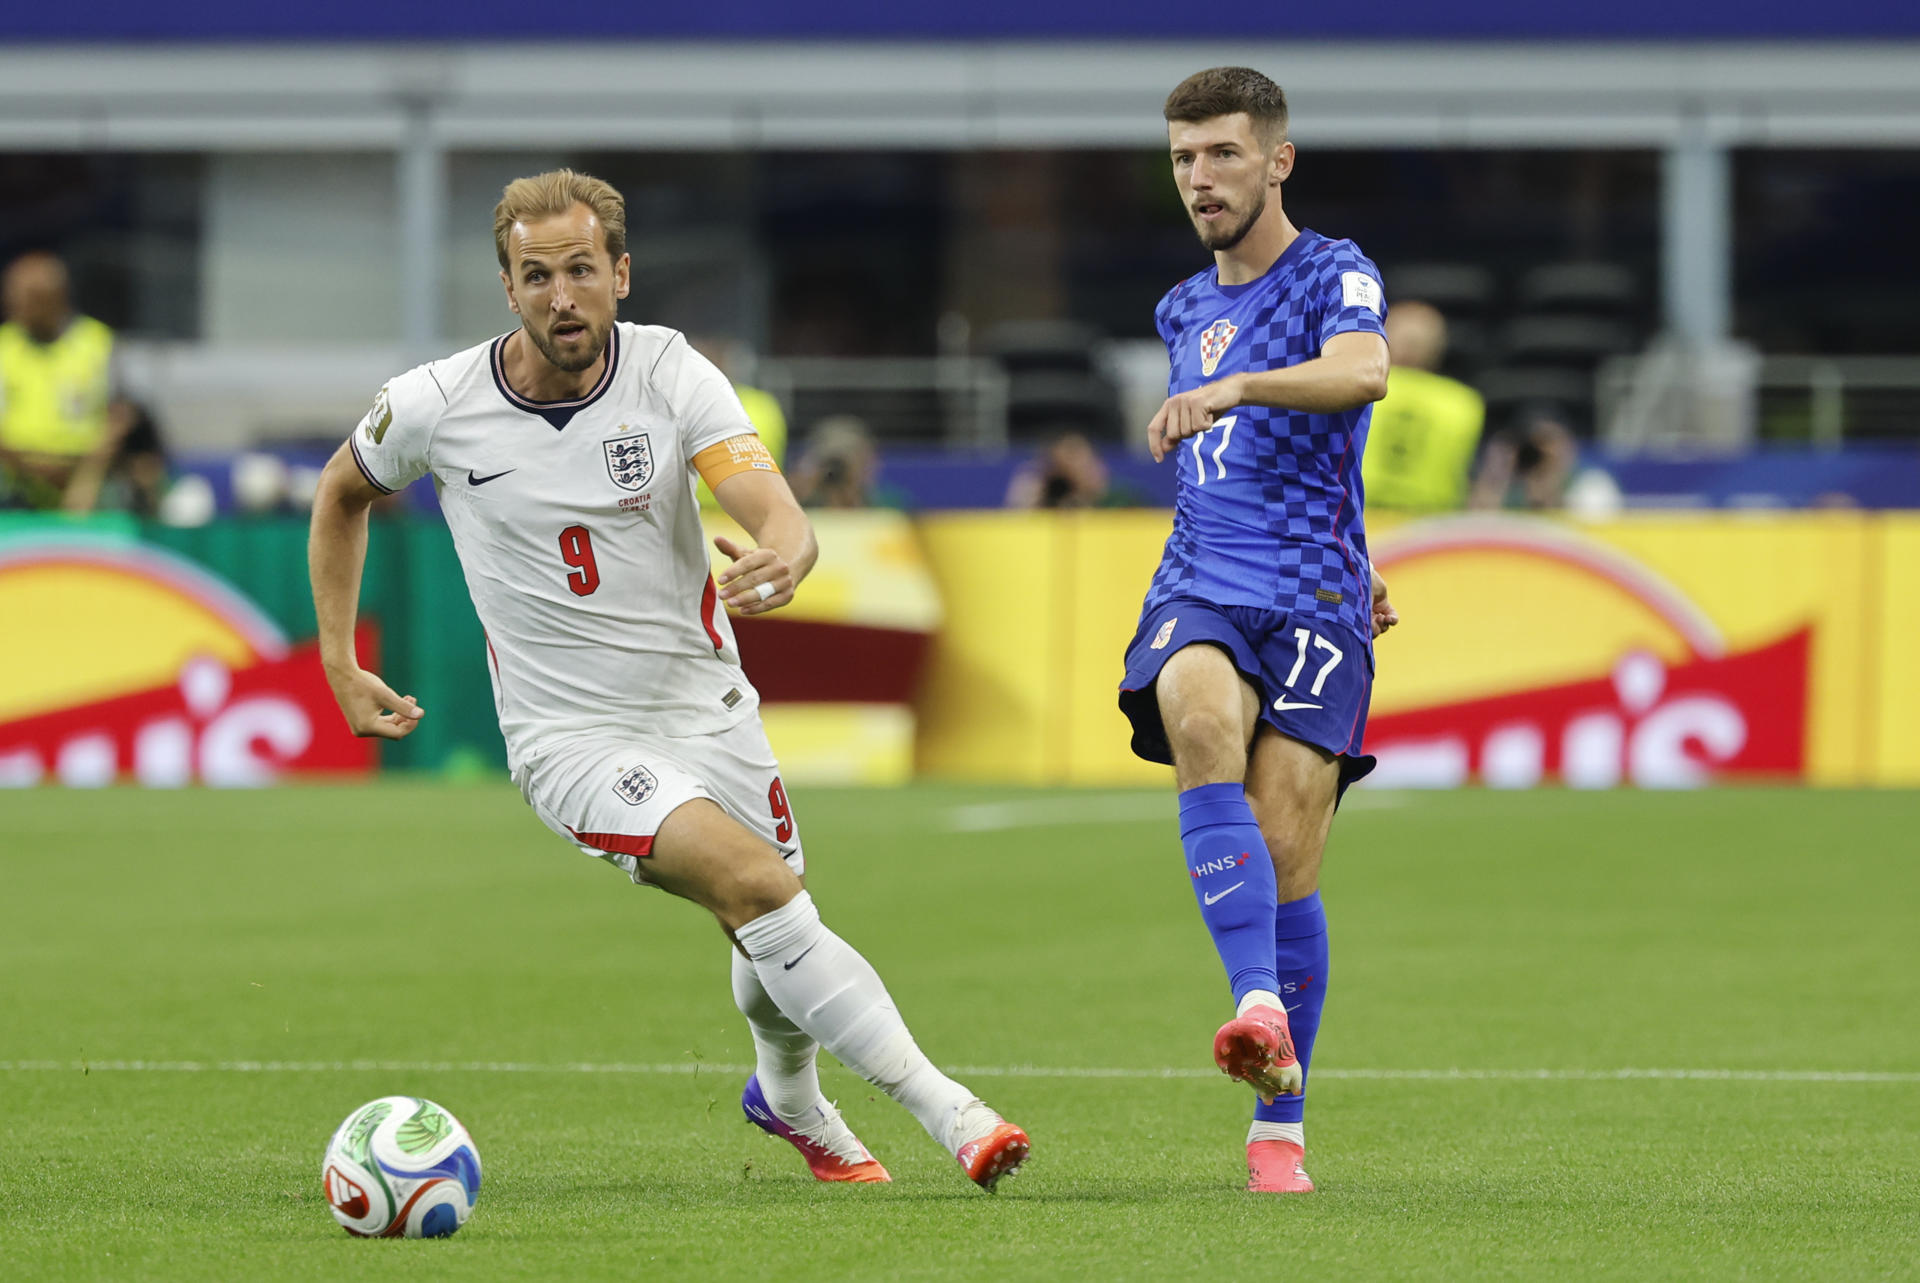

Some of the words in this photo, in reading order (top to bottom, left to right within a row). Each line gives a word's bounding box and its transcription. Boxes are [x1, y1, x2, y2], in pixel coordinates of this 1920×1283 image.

[1192, 415, 1238, 486] 17
[618, 492, 651, 507] CROATIA
[558, 525, 601, 597] 9
[1284, 627, 1344, 697] 17
[767, 776, 794, 844] 9
[1196, 855, 1237, 878] HNS
